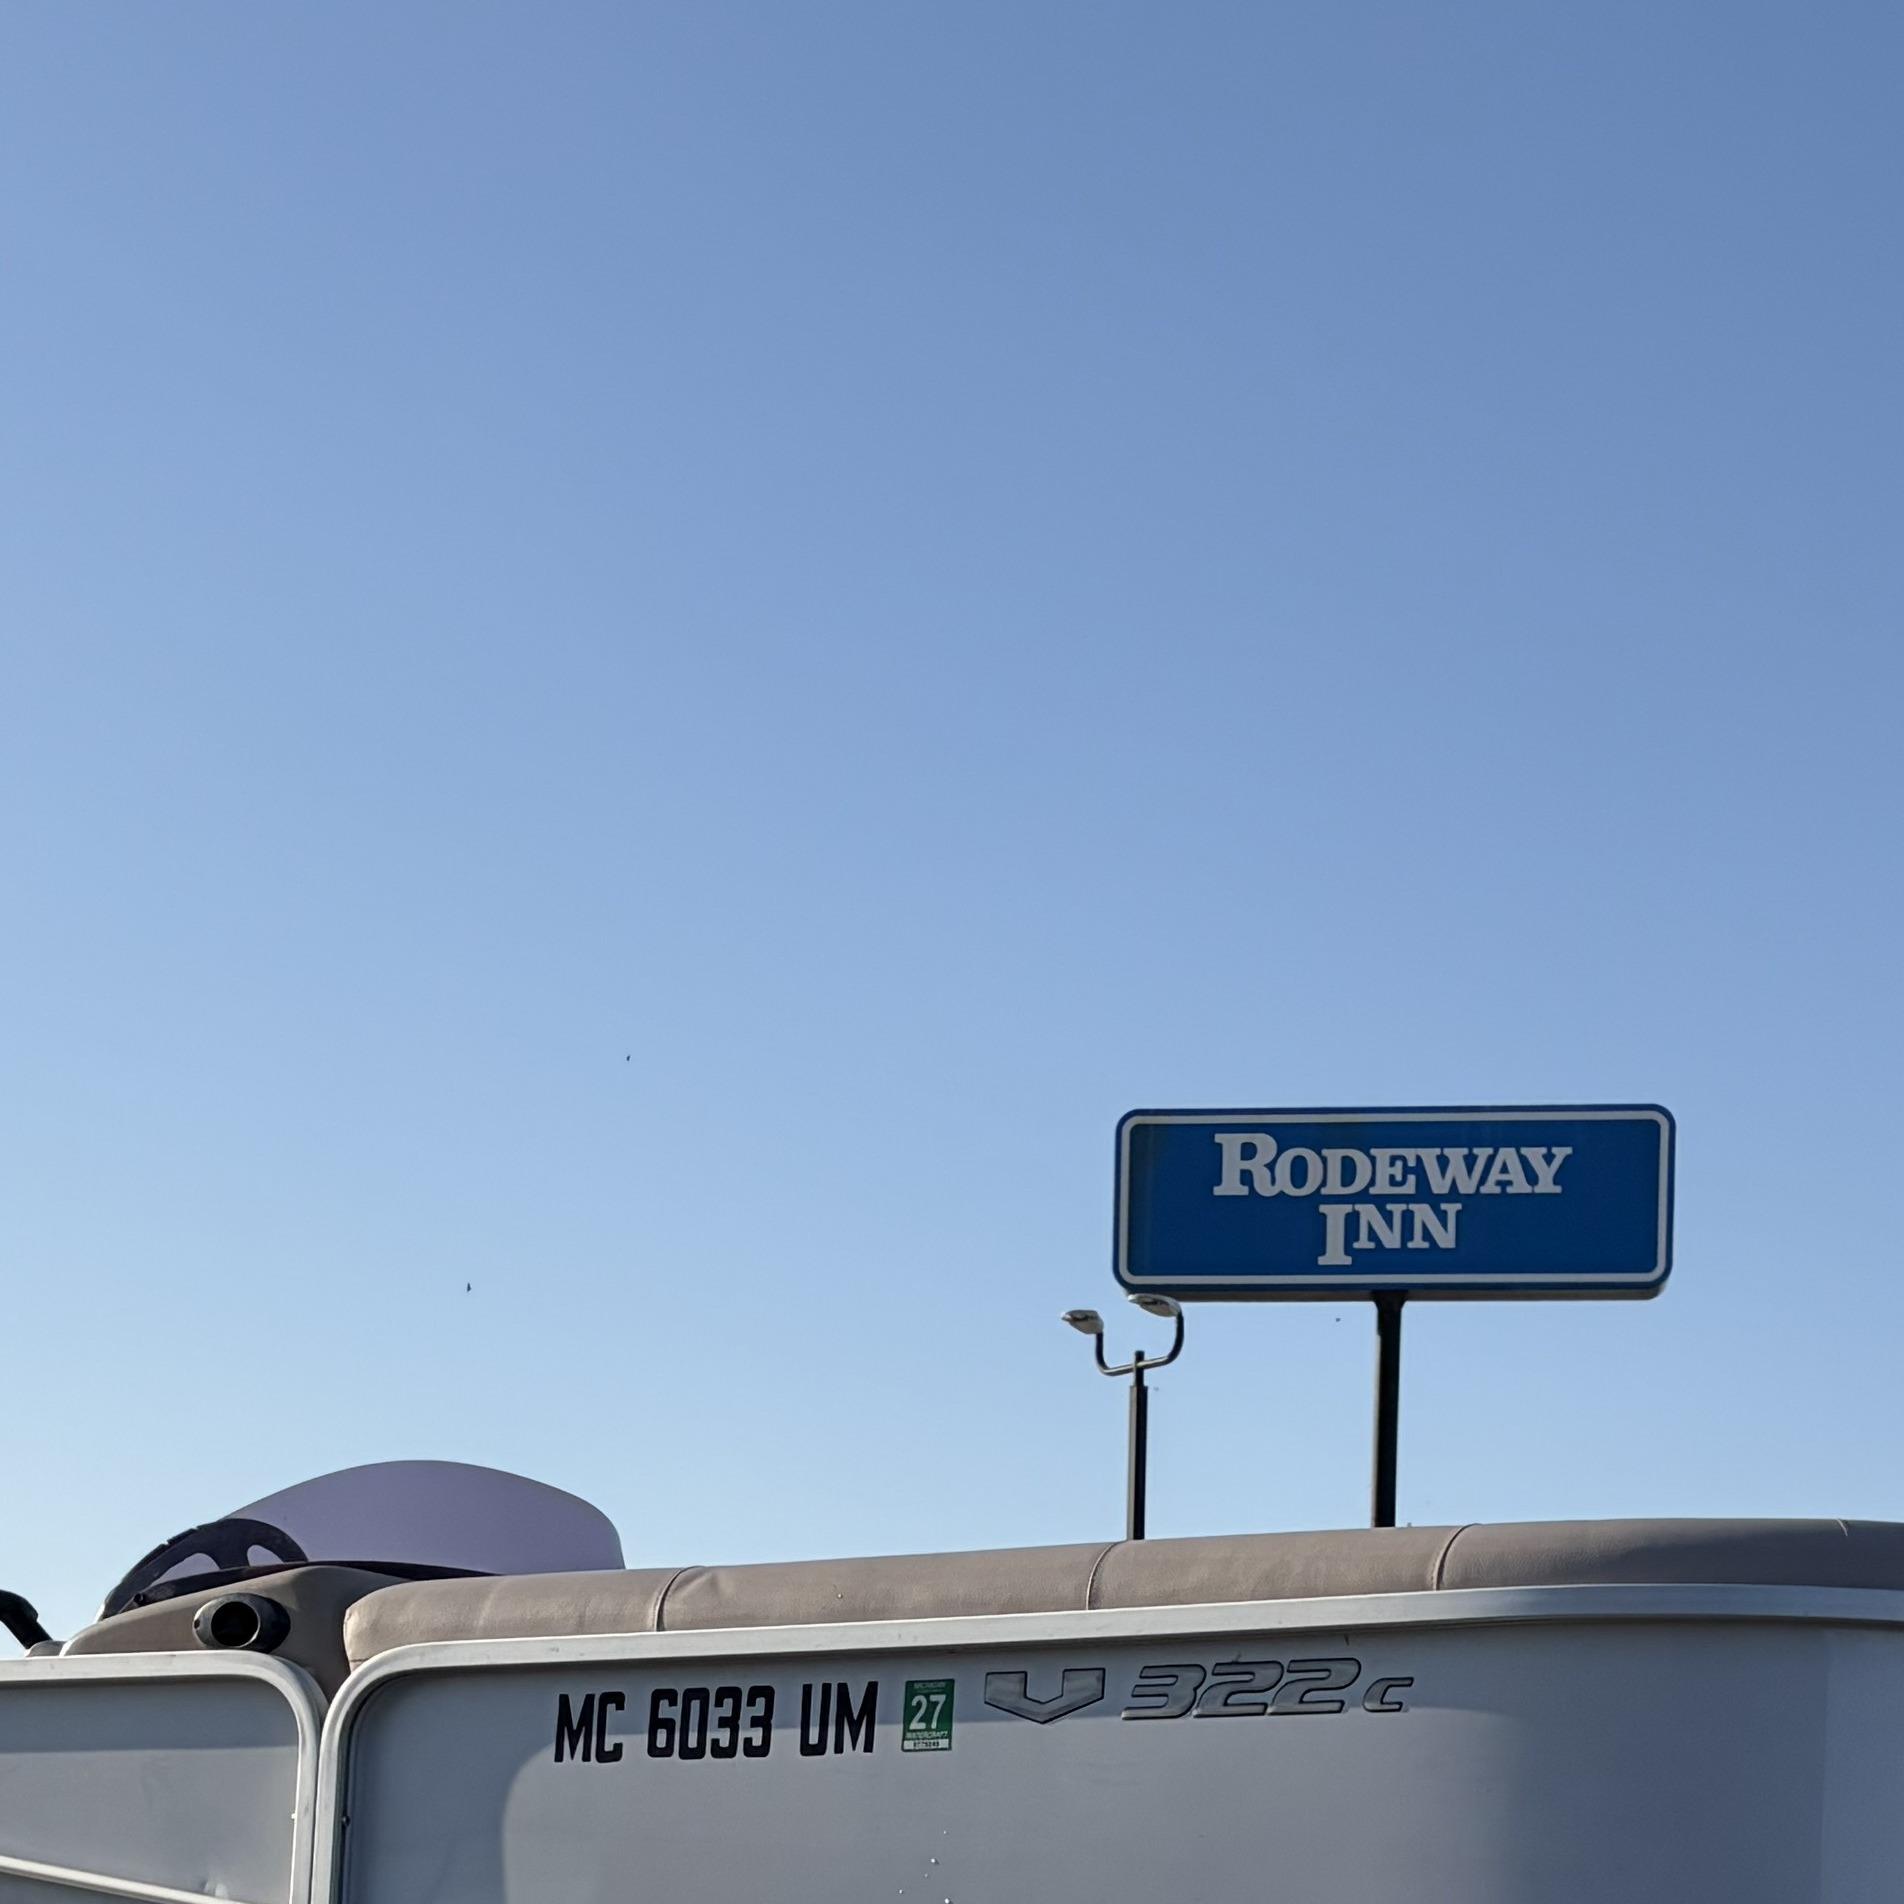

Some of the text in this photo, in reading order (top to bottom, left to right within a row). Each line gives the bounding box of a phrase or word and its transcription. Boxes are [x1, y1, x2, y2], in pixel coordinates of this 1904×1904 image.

[1212, 1133, 1573, 1197] RODEWAY
[1317, 1203, 1462, 1265] INN
[554, 1681, 879, 1763] MC 6033 UM
[909, 1694, 947, 1730] 27
